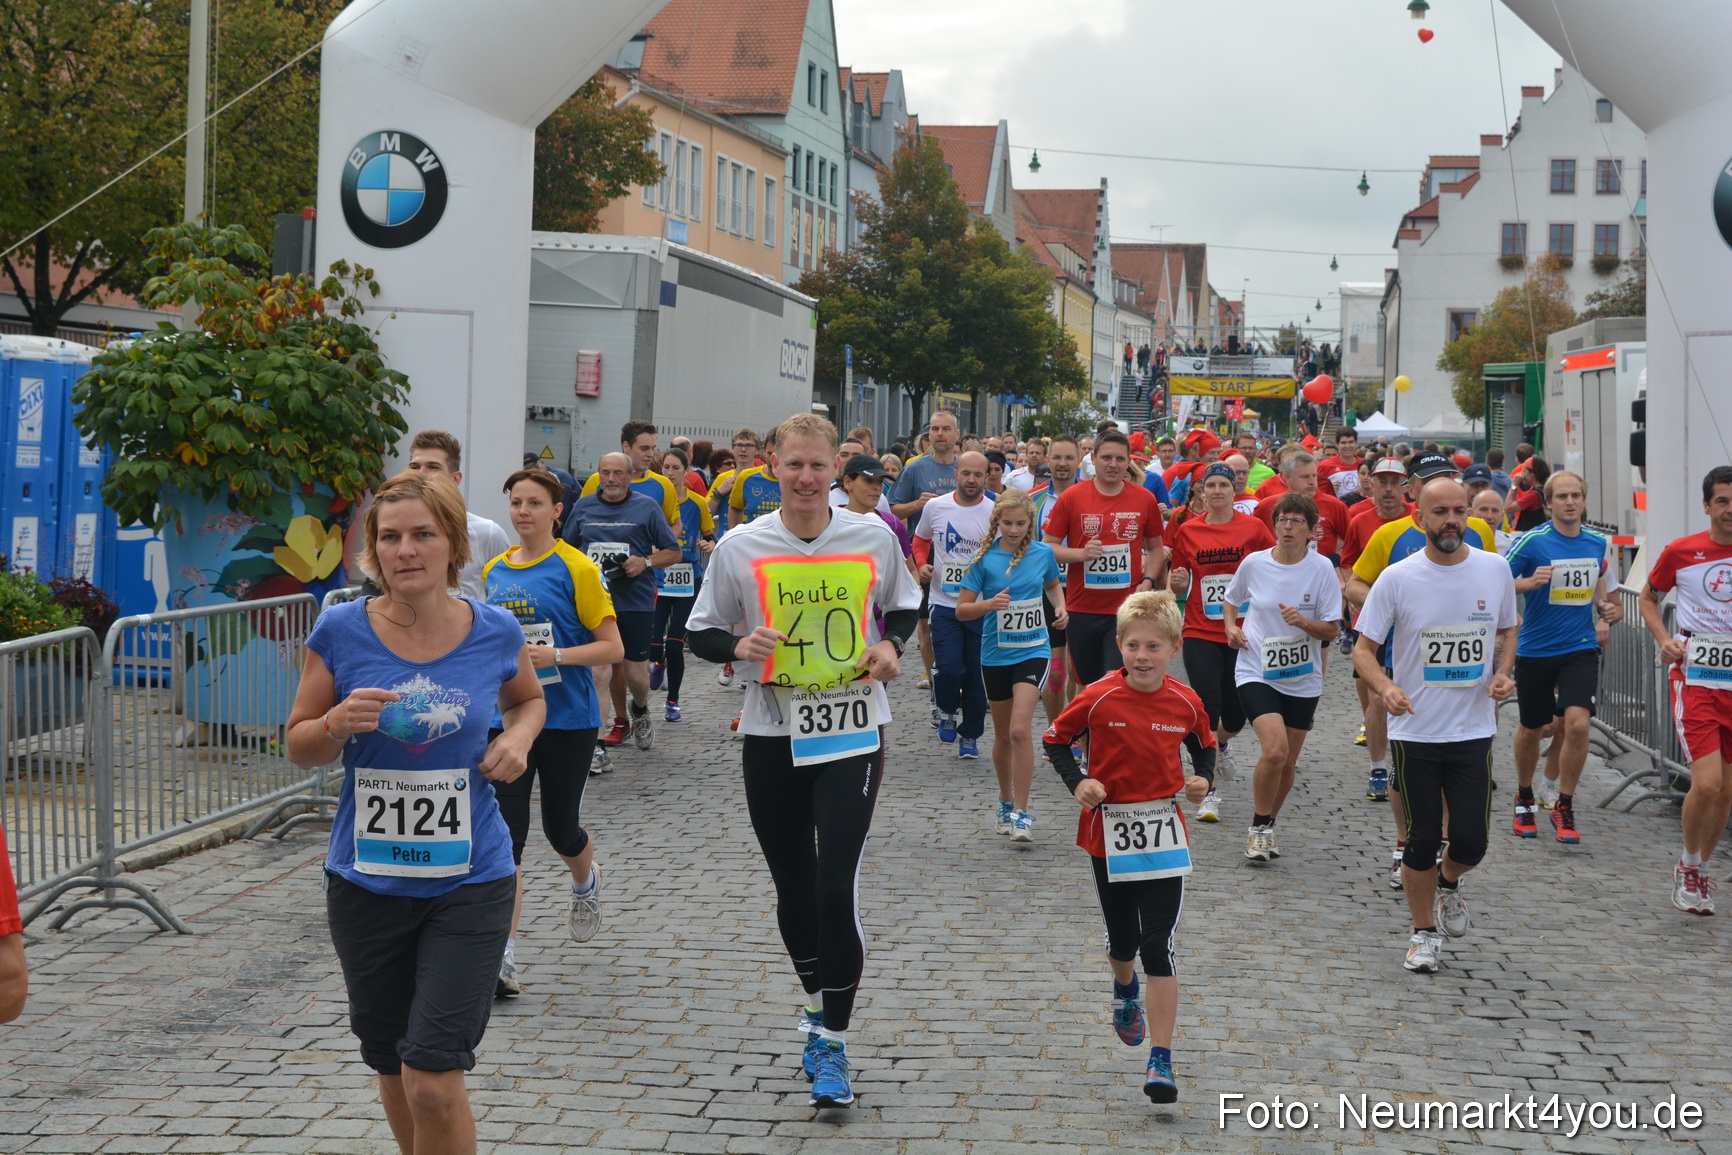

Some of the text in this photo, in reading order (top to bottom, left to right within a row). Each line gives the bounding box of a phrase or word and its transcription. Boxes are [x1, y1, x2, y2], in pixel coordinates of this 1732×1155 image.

[348, 133, 441, 173] BMW
[1210, 381, 1254, 393] START
[1088, 555, 1128, 573] 2394
[945, 568, 962, 582] 28
[1096, 575, 1120, 583] Patrick
[1563, 570, 1590, 588] 181
[777, 579, 849, 606] heute
[1206, 585, 1226, 603] 23
[1003, 609, 1042, 630] 2760
[783, 607, 856, 667] 40
[1266, 644, 1309, 668] 2650
[1428, 639, 1483, 664] 2769
[1694, 646, 1732, 668] 286
[1279, 669, 1300, 677] Maria
[1445, 669, 1470, 679] Peter
[1698, 669, 1732, 681] Johanne
[820, 689, 860, 700] Neumarkt
[798, 700, 869, 735] 3370
[1151, 722, 1186, 733] FC Holzheim
[358, 779, 450, 792] PARTL Neumarkt
[366, 795, 461, 836] 2124
[1104, 806, 1171, 819] PARTL Neumarkt
[1113, 816, 1179, 852] 3371
[392, 846, 431, 863] Petra
